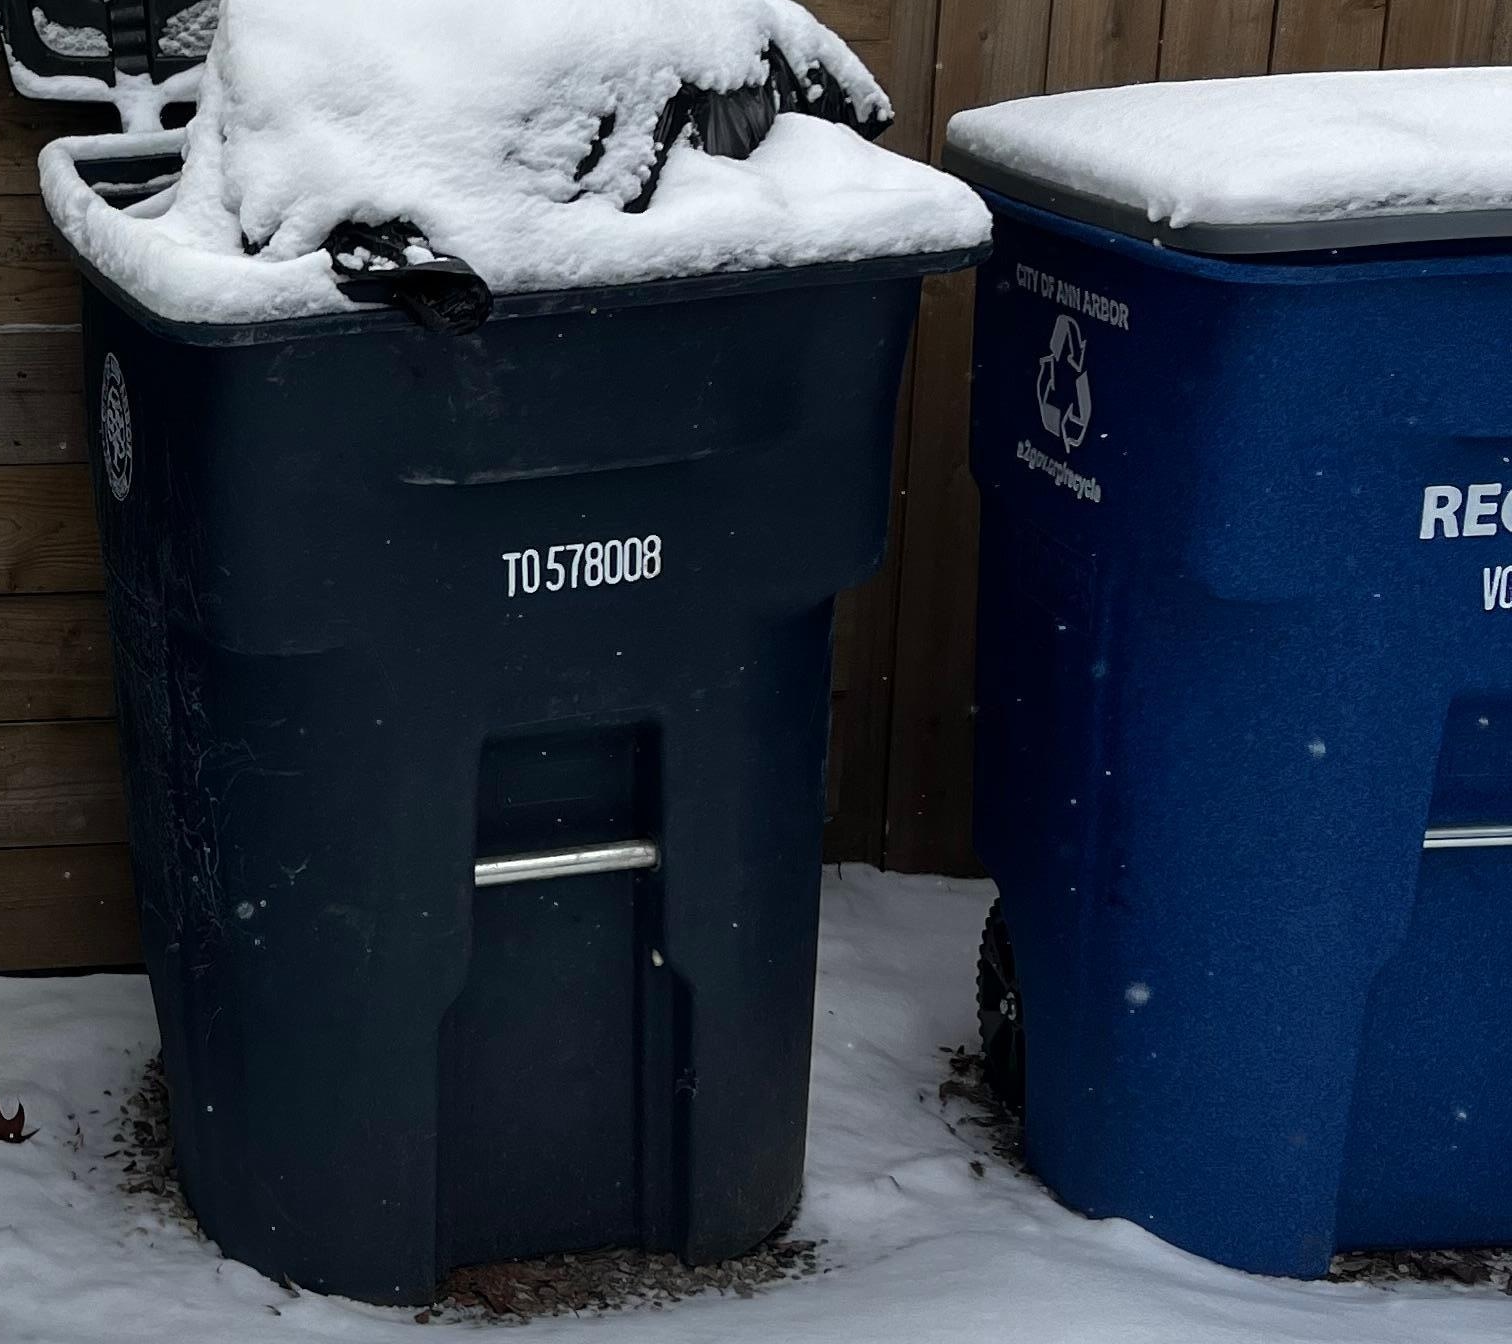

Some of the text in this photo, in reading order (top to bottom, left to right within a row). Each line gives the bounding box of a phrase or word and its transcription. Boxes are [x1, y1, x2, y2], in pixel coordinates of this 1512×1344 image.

[1016, 263, 1129, 331] CITY OF ANN ARBOR
[1419, 483, 1512, 540] RE
